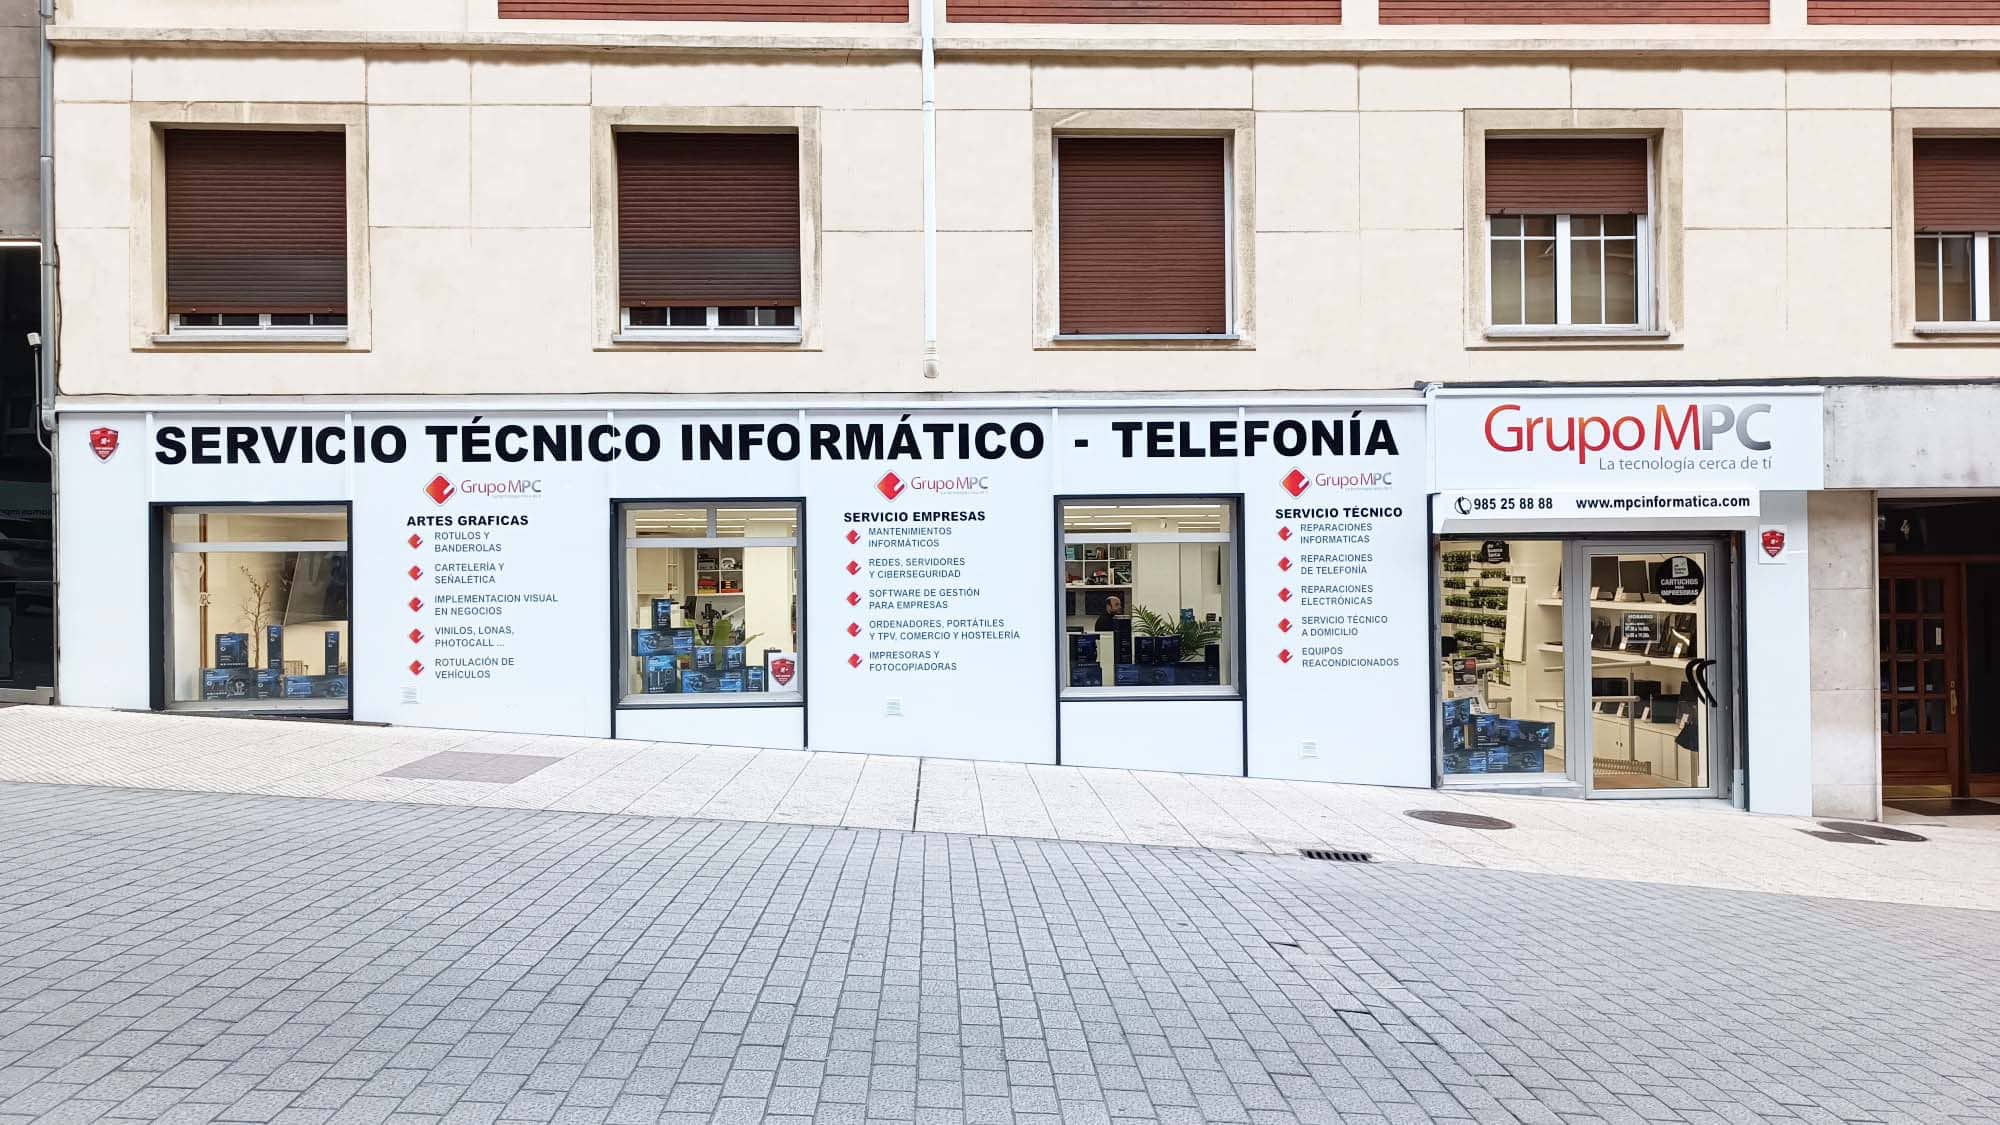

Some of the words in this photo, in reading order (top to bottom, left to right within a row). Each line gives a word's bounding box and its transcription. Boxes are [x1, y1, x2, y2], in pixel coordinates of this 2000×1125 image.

[155, 426, 406, 464] SERVICIO
[426, 417, 661, 463] TÉCNICO
[681, 415, 1044, 461] INFORMÁTICO
[1074, 439, 1089, 448] -
[1112, 412, 1399, 458] TELEFONÍA
[1599, 456, 1614, 471] La
[1619, 456, 1695, 473] tecnología
[1699, 457, 1737, 471] cerca
[1740, 456, 1758, 471] de
[1473, 498, 1496, 511] 985
[1501, 497, 1516, 510] 25
[1519, 497, 1535, 510] 88
[1537, 497, 1553, 510] 88
[1576, 495, 1750, 511] www.mpcinformatica.com
[844, 512, 908, 523] SERVICIO
[913, 511, 985, 522] EMPRESAS
[1276, 508, 1338, 519] SERVICIO
[1343, 506, 1402, 518] TÉCNICO
[407, 515, 453, 526] ARTES
[457, 514, 529, 526] GRAFICAS
[869, 527, 952, 536] MANTENIMIENTOS
[1300, 523, 1372, 532] REPARACIONES
[435, 532, 480, 540] ROTULOS
[484, 532, 490, 540] Y
[1300, 535, 1370, 544] INFORMATICAS
[435, 543, 502, 552] BANDEROLAS
[869, 538, 940, 548] INFORMÁTICOS
[869, 558, 903, 568] REDES,
[906, 558, 965, 567] SERVIDORES
[1301, 554, 1373, 563] REPARACIONES
[435, 562, 494, 572] CARTELERÍA
[497, 563, 504, 571] Y
[1301, 566, 1315, 574] DE
[1316, 565, 1367, 574] TELEFONÍA
[435, 573, 496, 584] SEÑALÉTICA
[869, 570, 876, 578] Y
[878, 570, 961, 578] CIBERSEGURIDAD
[869, 589, 921, 598] SOFTWARE
[924, 589, 937, 597] DE
[939, 587, 980, 597] GESTIÓN
[1301, 585, 1373, 593] REPARACIONES
[435, 593, 520, 603] IMPLEMENTACION
[523, 593, 558, 602] VISUAL
[1301, 595, 1372, 605] ELECTRÓNICAS
[869, 601, 893, 609] PARA
[896, 601, 948, 609] EMPRESAS
[435, 607, 447, 616] EN
[451, 607, 502, 615] NEGOCIOS
[869, 619, 943, 629] ORDENADORES,
[946, 617, 1004, 628] PORTÁTILES
[1301, 616, 1344, 624] SERVICIO
[1346, 614, 1387, 624] TÉCNICO
[435, 626, 476, 636] VINILOS,
[479, 626, 514, 636] LONAS,
[878, 632, 897, 641] TPV,
[902, 631, 950, 640] COMERCIO
[953, 631, 959, 639] Y
[961, 629, 1020, 639] HOSTELERÍA
[1310, 627, 1358, 636] DOMICILIO
[435, 638, 494, 647] PHOTOCALL
[870, 651, 930, 660] IMPRESORAS
[933, 651, 939, 659] Y
[1302, 647, 1342, 656] EQUIPOS
[435, 657, 499, 666] ROTULACIÓN
[502, 657, 514, 666] DE
[870, 662, 957, 671] FOTOCOPIADORAS
[1302, 658, 1399, 667] REACONDICIONADOS
[435, 669, 491, 679] VEHÍCULOS
